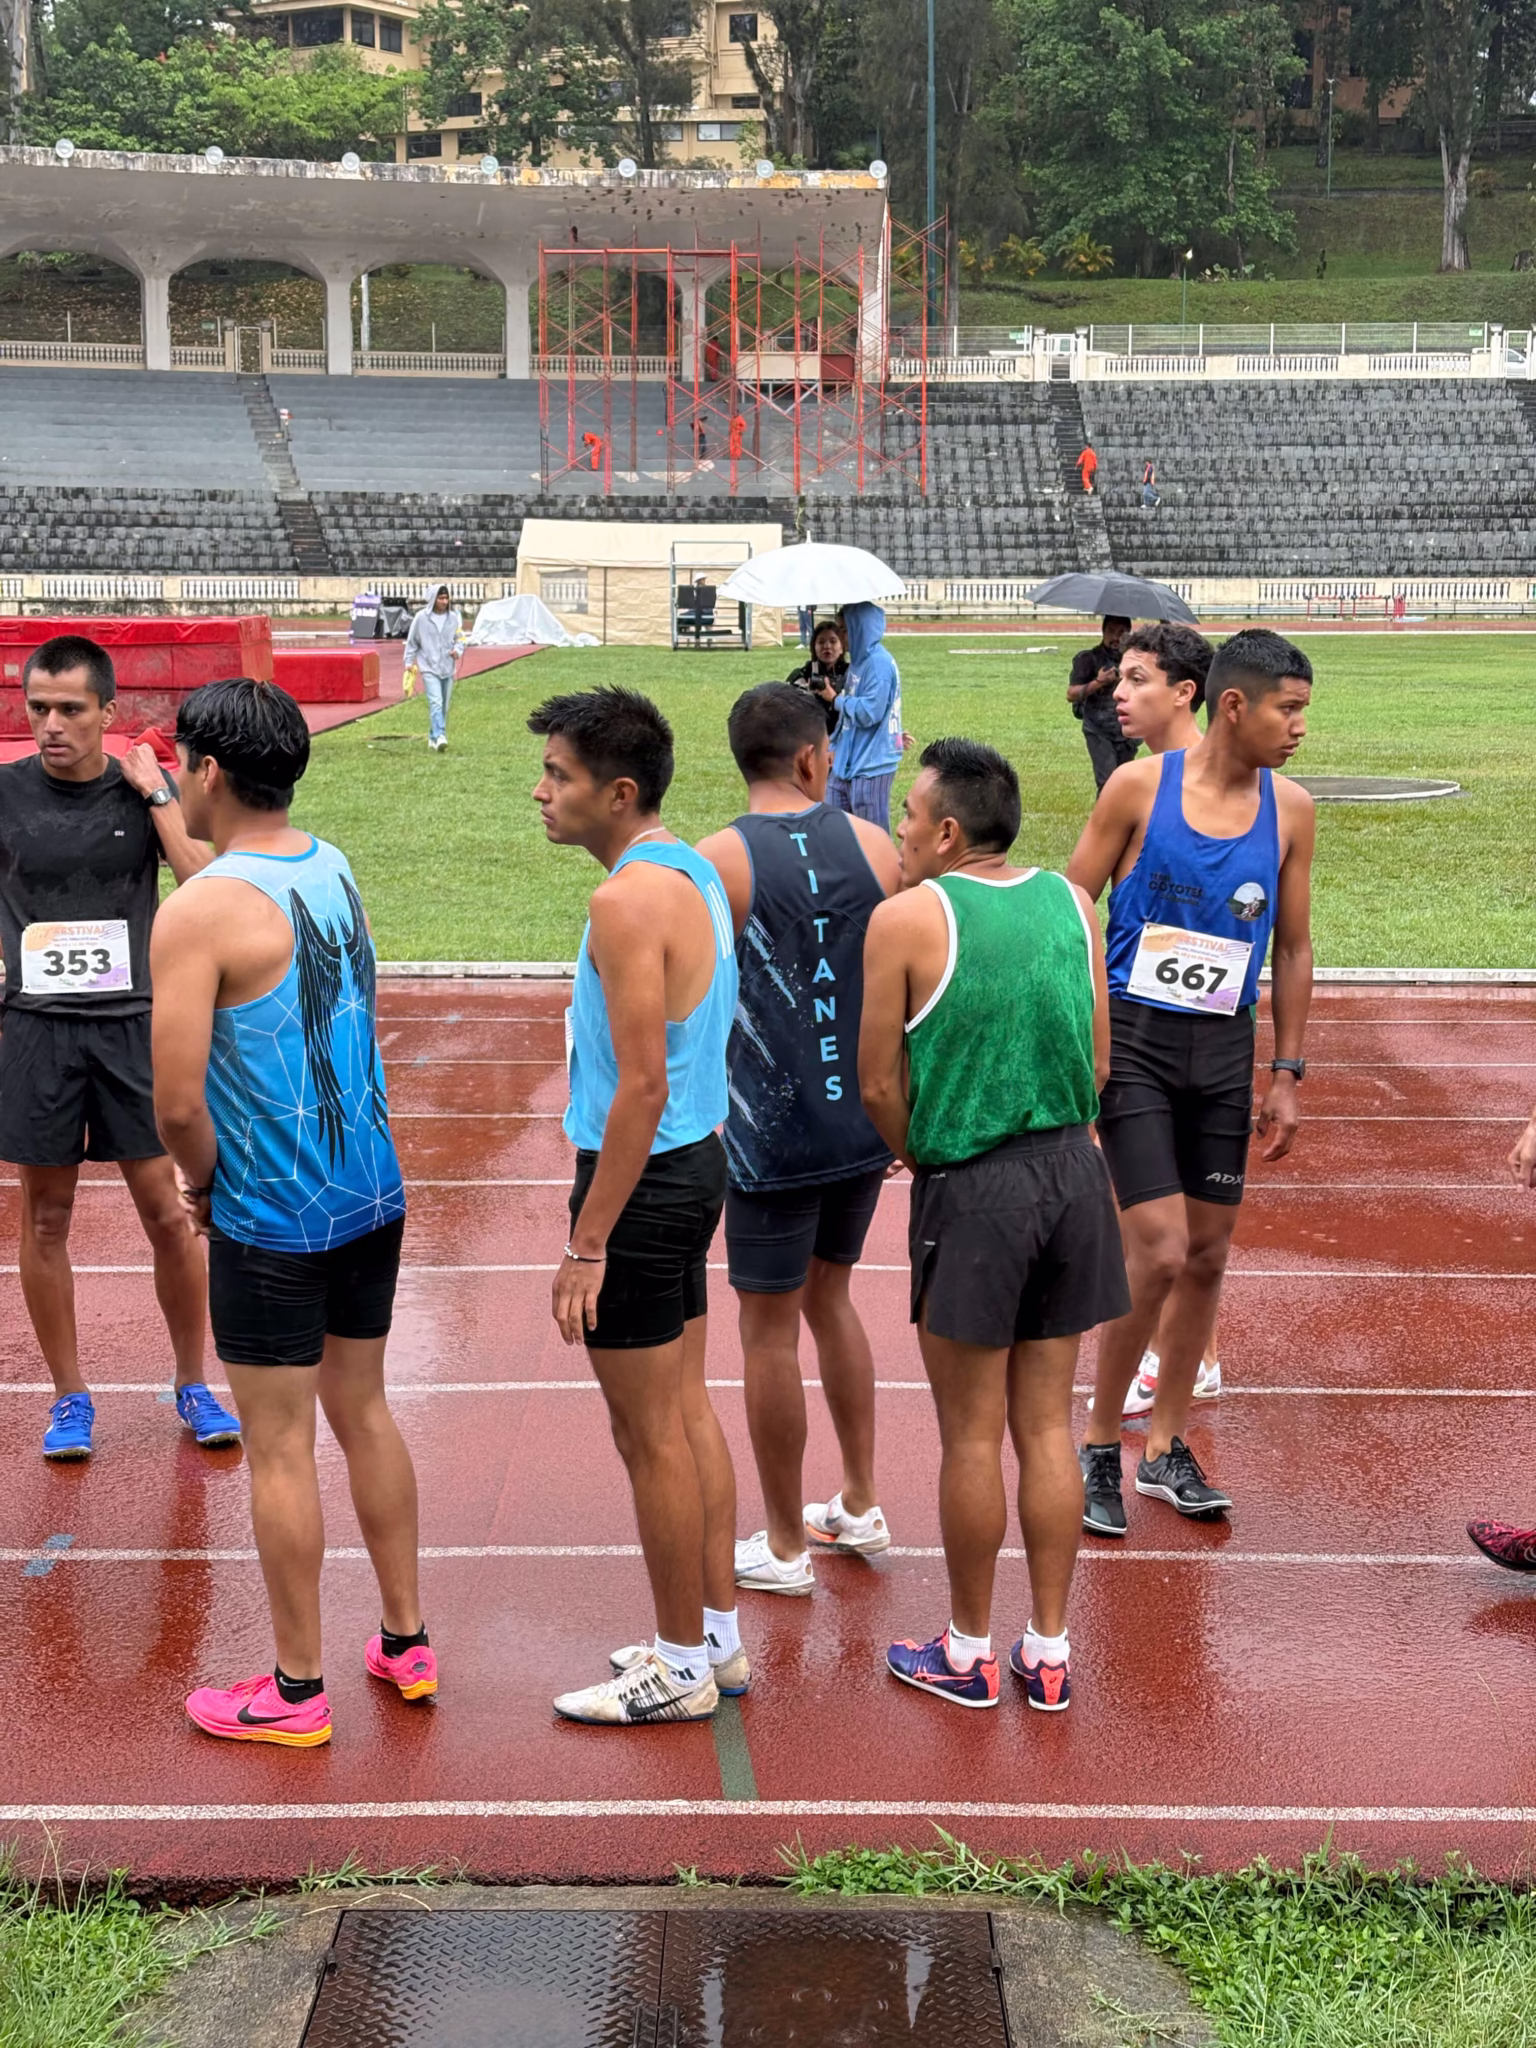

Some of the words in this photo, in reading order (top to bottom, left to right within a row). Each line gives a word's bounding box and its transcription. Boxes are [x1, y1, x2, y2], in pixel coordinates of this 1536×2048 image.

[1148, 880, 1203, 898] COYOTES
[54, 925, 109, 937] FESTIVAL
[1176, 934, 1230, 954] FESTIVAL
[42, 948, 112, 976] 353
[790, 832, 843, 1101] TITANES
[1155, 957, 1229, 995] 667
[1206, 1172, 1244, 1185] ADX
